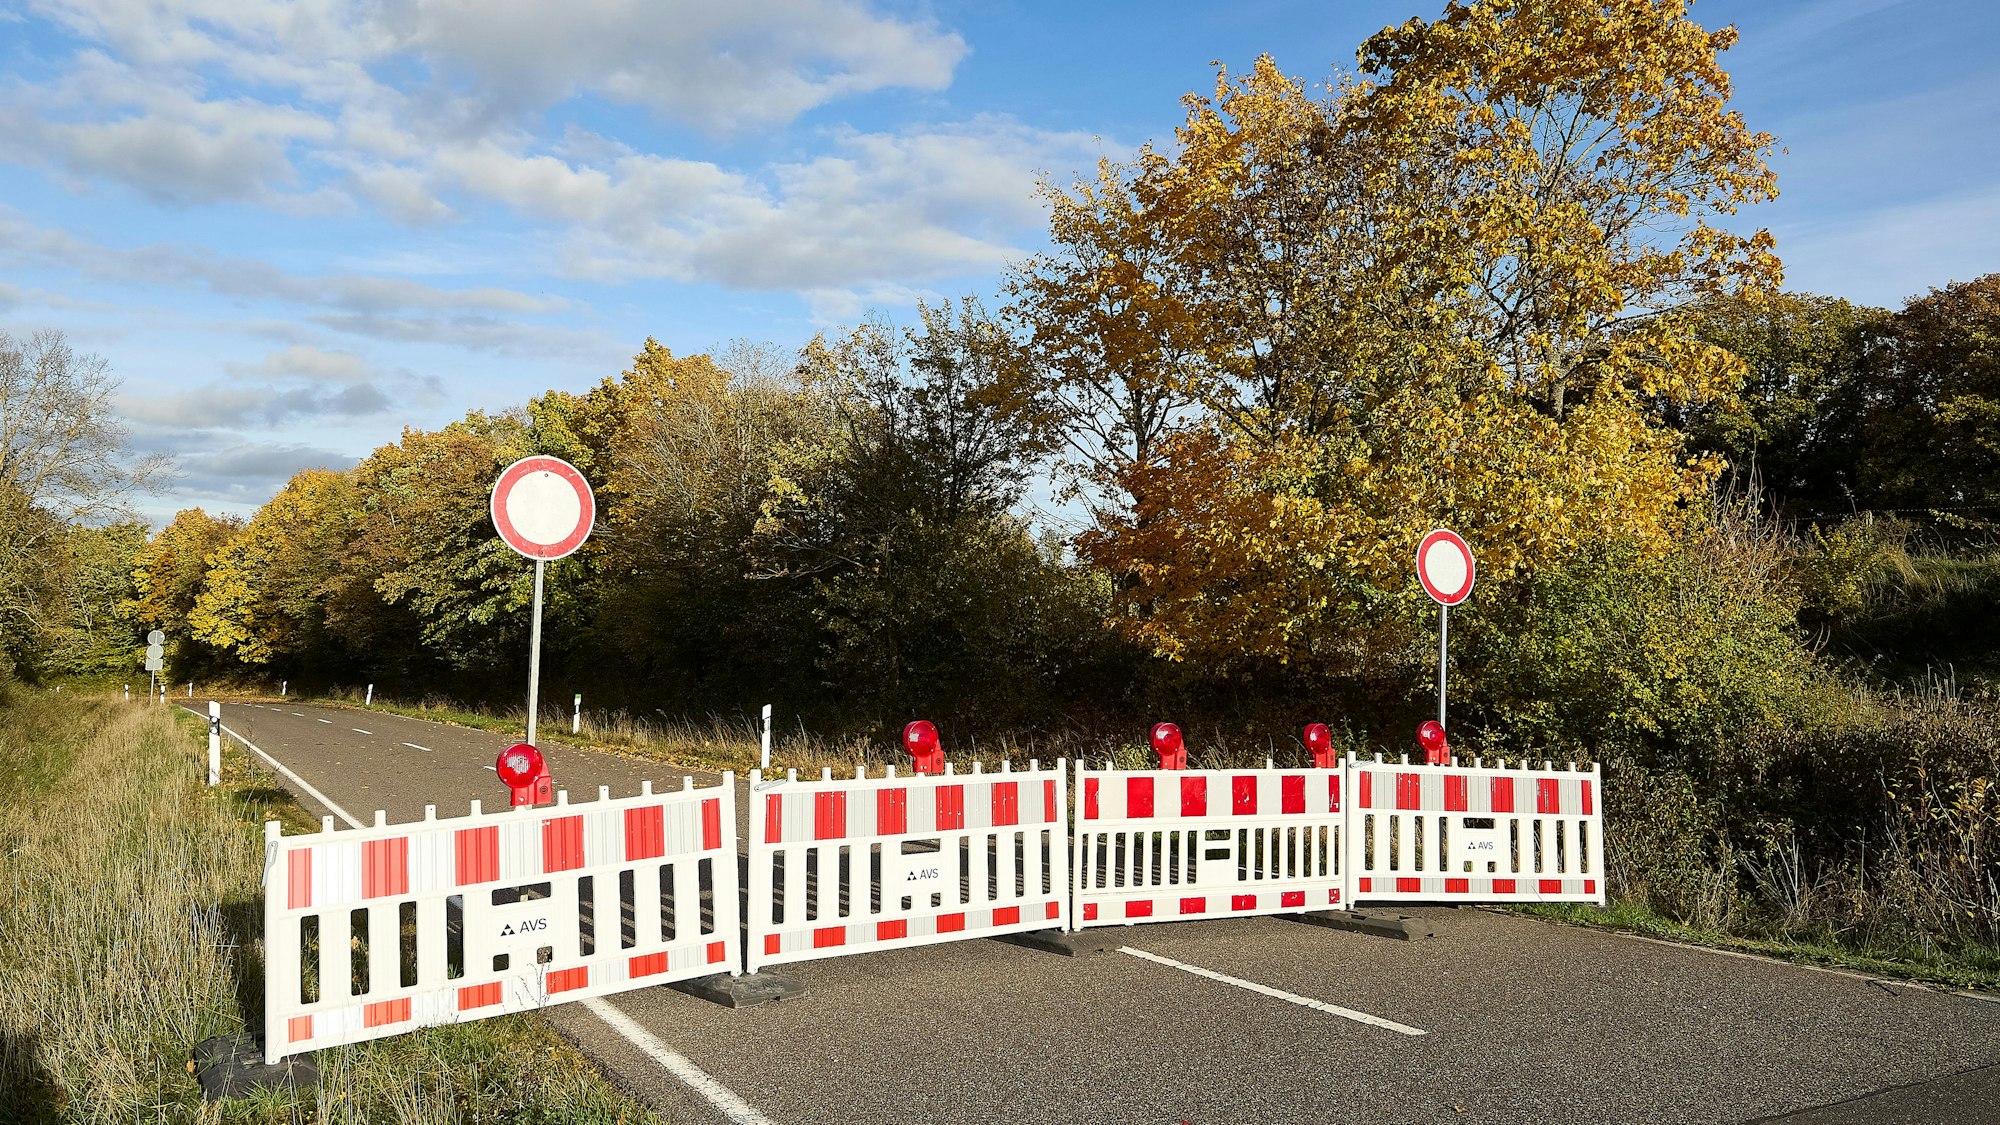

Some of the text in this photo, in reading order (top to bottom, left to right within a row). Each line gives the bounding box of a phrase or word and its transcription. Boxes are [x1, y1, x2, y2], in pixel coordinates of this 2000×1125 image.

[1478, 841, 1493, 850] AVS
[920, 868, 938, 879] AVS
[520, 918, 547, 933] AVS
